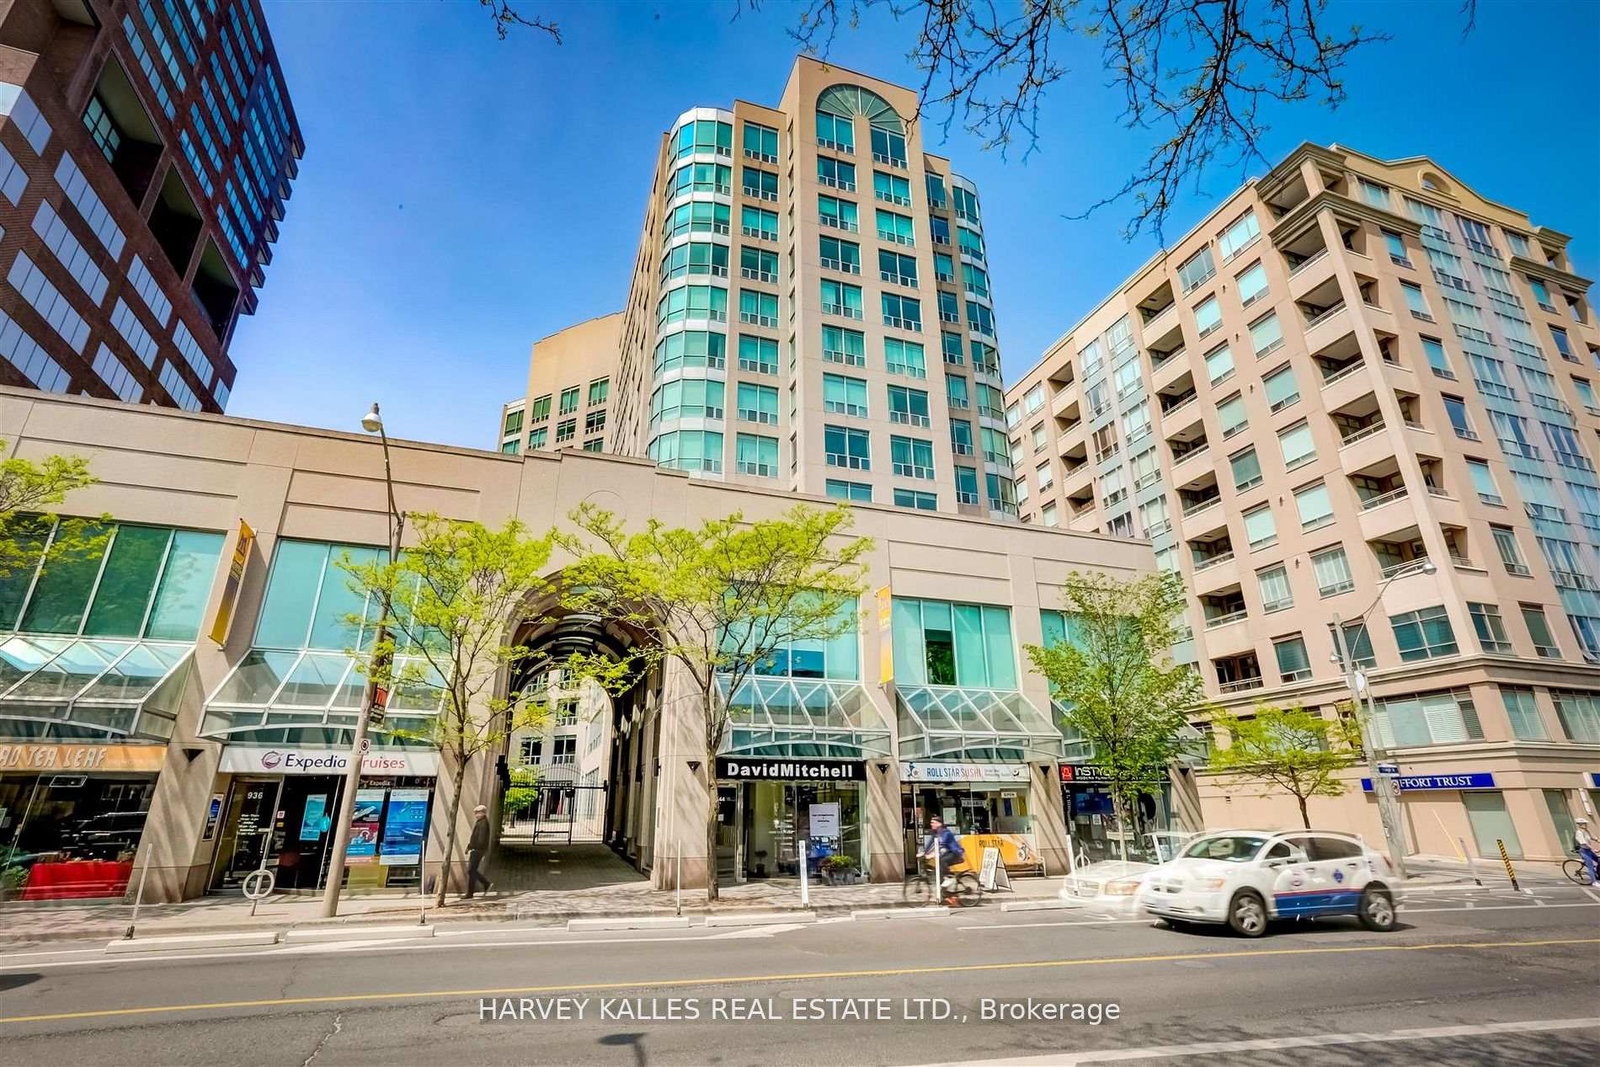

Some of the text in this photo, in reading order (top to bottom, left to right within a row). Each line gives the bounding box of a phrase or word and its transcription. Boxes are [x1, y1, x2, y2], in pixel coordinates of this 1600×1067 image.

[28, 745, 58, 768] TEA
[63, 746, 107, 769] LEAF
[285, 753, 406, 773] Expedia ruises
[727, 762, 853, 778] DavidMitchell
[926, 767, 943, 778] ROLL
[1400, 776, 1473, 788] FFORT TRUST
